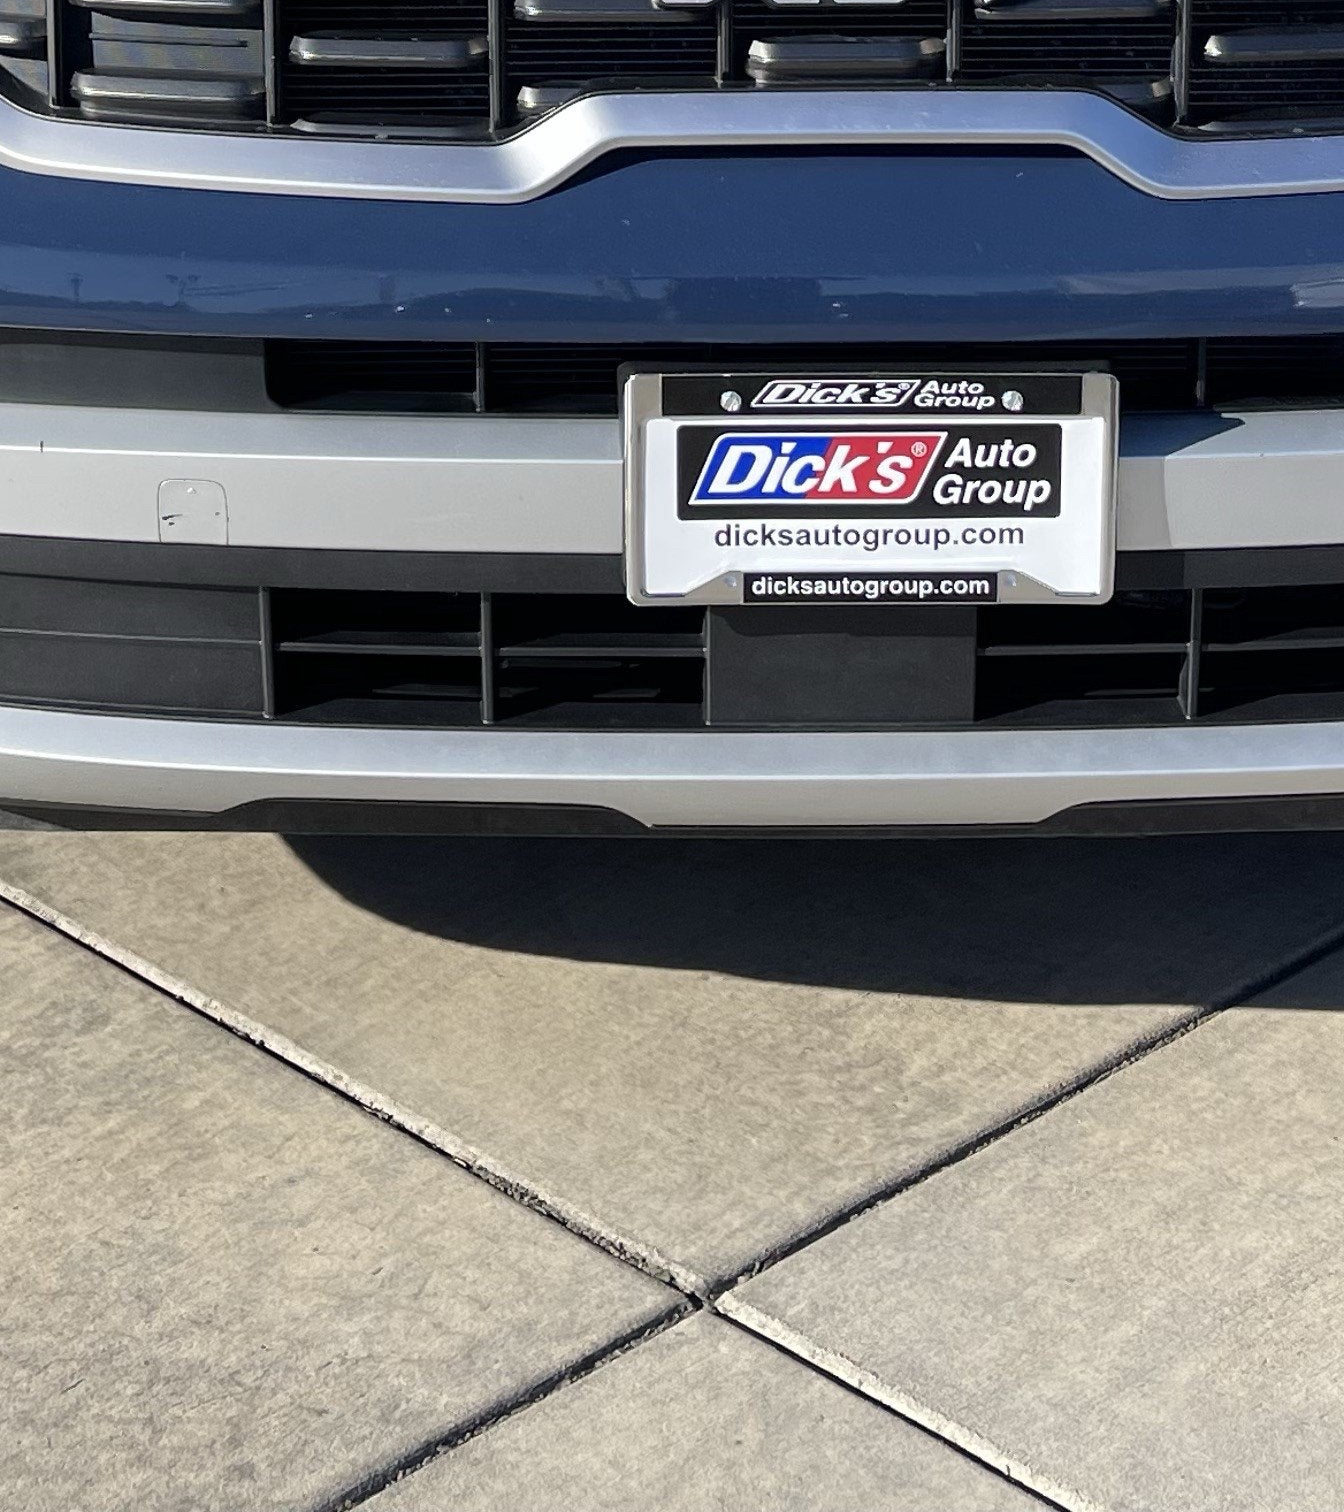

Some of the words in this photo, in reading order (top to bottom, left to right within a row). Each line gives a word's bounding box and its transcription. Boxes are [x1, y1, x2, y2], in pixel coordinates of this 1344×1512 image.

[921, 380, 985, 395] Auto
[913, 392, 996, 410] Group
[943, 437, 1038, 469] Auto
[932, 473, 1052, 511] Group
[713, 523, 1026, 551] dicksautogroup.com
[750, 575, 991, 600] dicksautogroup.com
